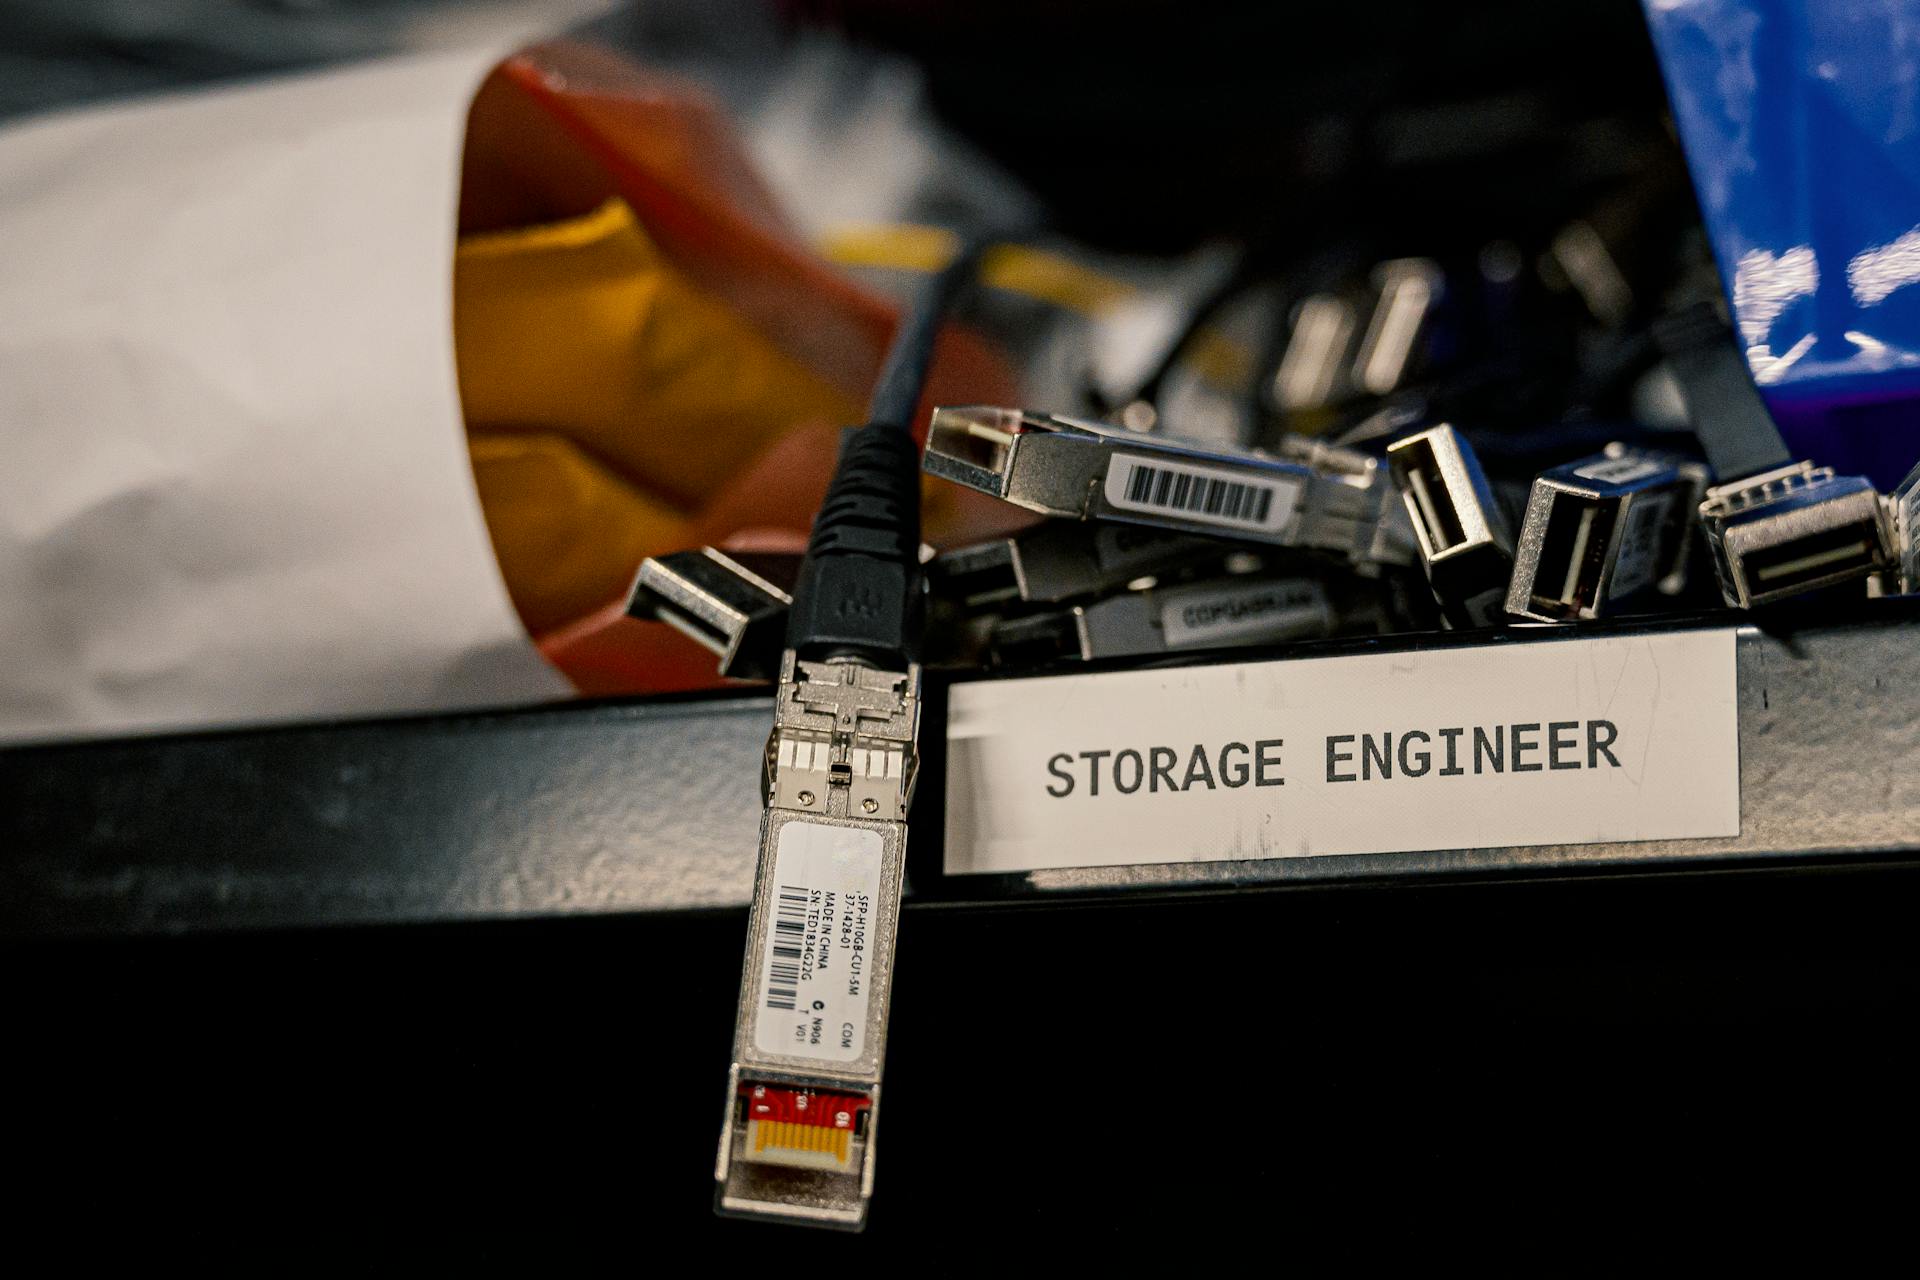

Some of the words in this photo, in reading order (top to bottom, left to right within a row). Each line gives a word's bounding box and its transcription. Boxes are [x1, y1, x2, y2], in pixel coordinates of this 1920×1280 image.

[1046, 739, 1285, 798] STORAGE
[1326, 719, 1621, 784] ENGINEER
[810, 890, 822, 906] SN:
[823, 891, 836, 922] MADE
[821, 924, 832, 934] IN
[840, 894, 856, 949] 37-1428-01
[801, 909, 820, 981] TED1834G22G
[817, 937, 831, 969] CHINA
[849, 895, 869, 996] SFP-H10GB-CU1-5M
[841, 1023, 854, 1048] COM
